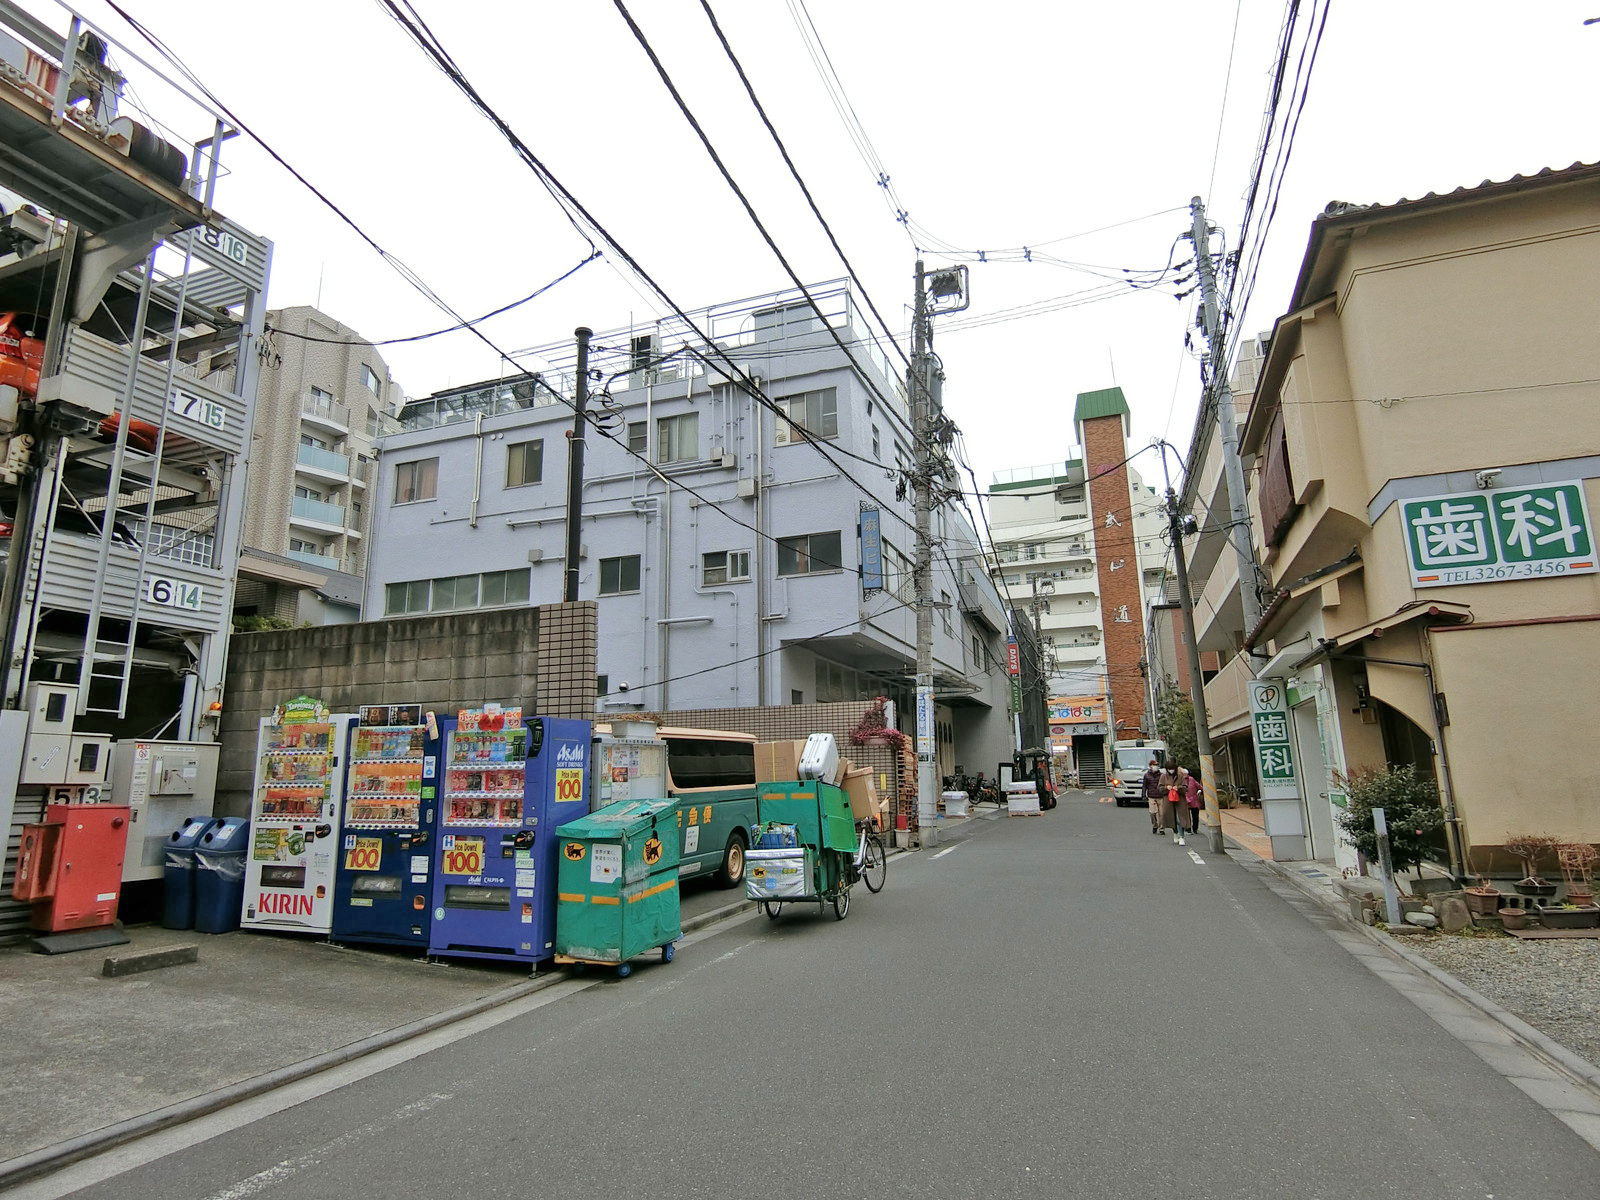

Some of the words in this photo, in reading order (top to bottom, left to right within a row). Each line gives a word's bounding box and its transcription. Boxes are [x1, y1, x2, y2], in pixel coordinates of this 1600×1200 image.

[204, 226, 220, 247] 8
[228, 237, 244, 261] 16
[181, 393, 198, 414] 7
[205, 403, 223, 427] 15
[1411, 490, 1581, 566] 歯科
[864, 518, 879, 582] 麻生ビル
[1444, 560, 1566, 583] TEL3267-3456
[153, 579, 171, 603] 6
[180, 584, 199, 608] 14
[1010, 648, 1018, 670] DAYS
[557, 744, 584, 761] Asahi
[1257, 715, 1292, 775] 歯科
[54, 788, 71, 804] 5
[77, 787, 100, 804] 13
[259, 892, 314, 916] KIRIN
